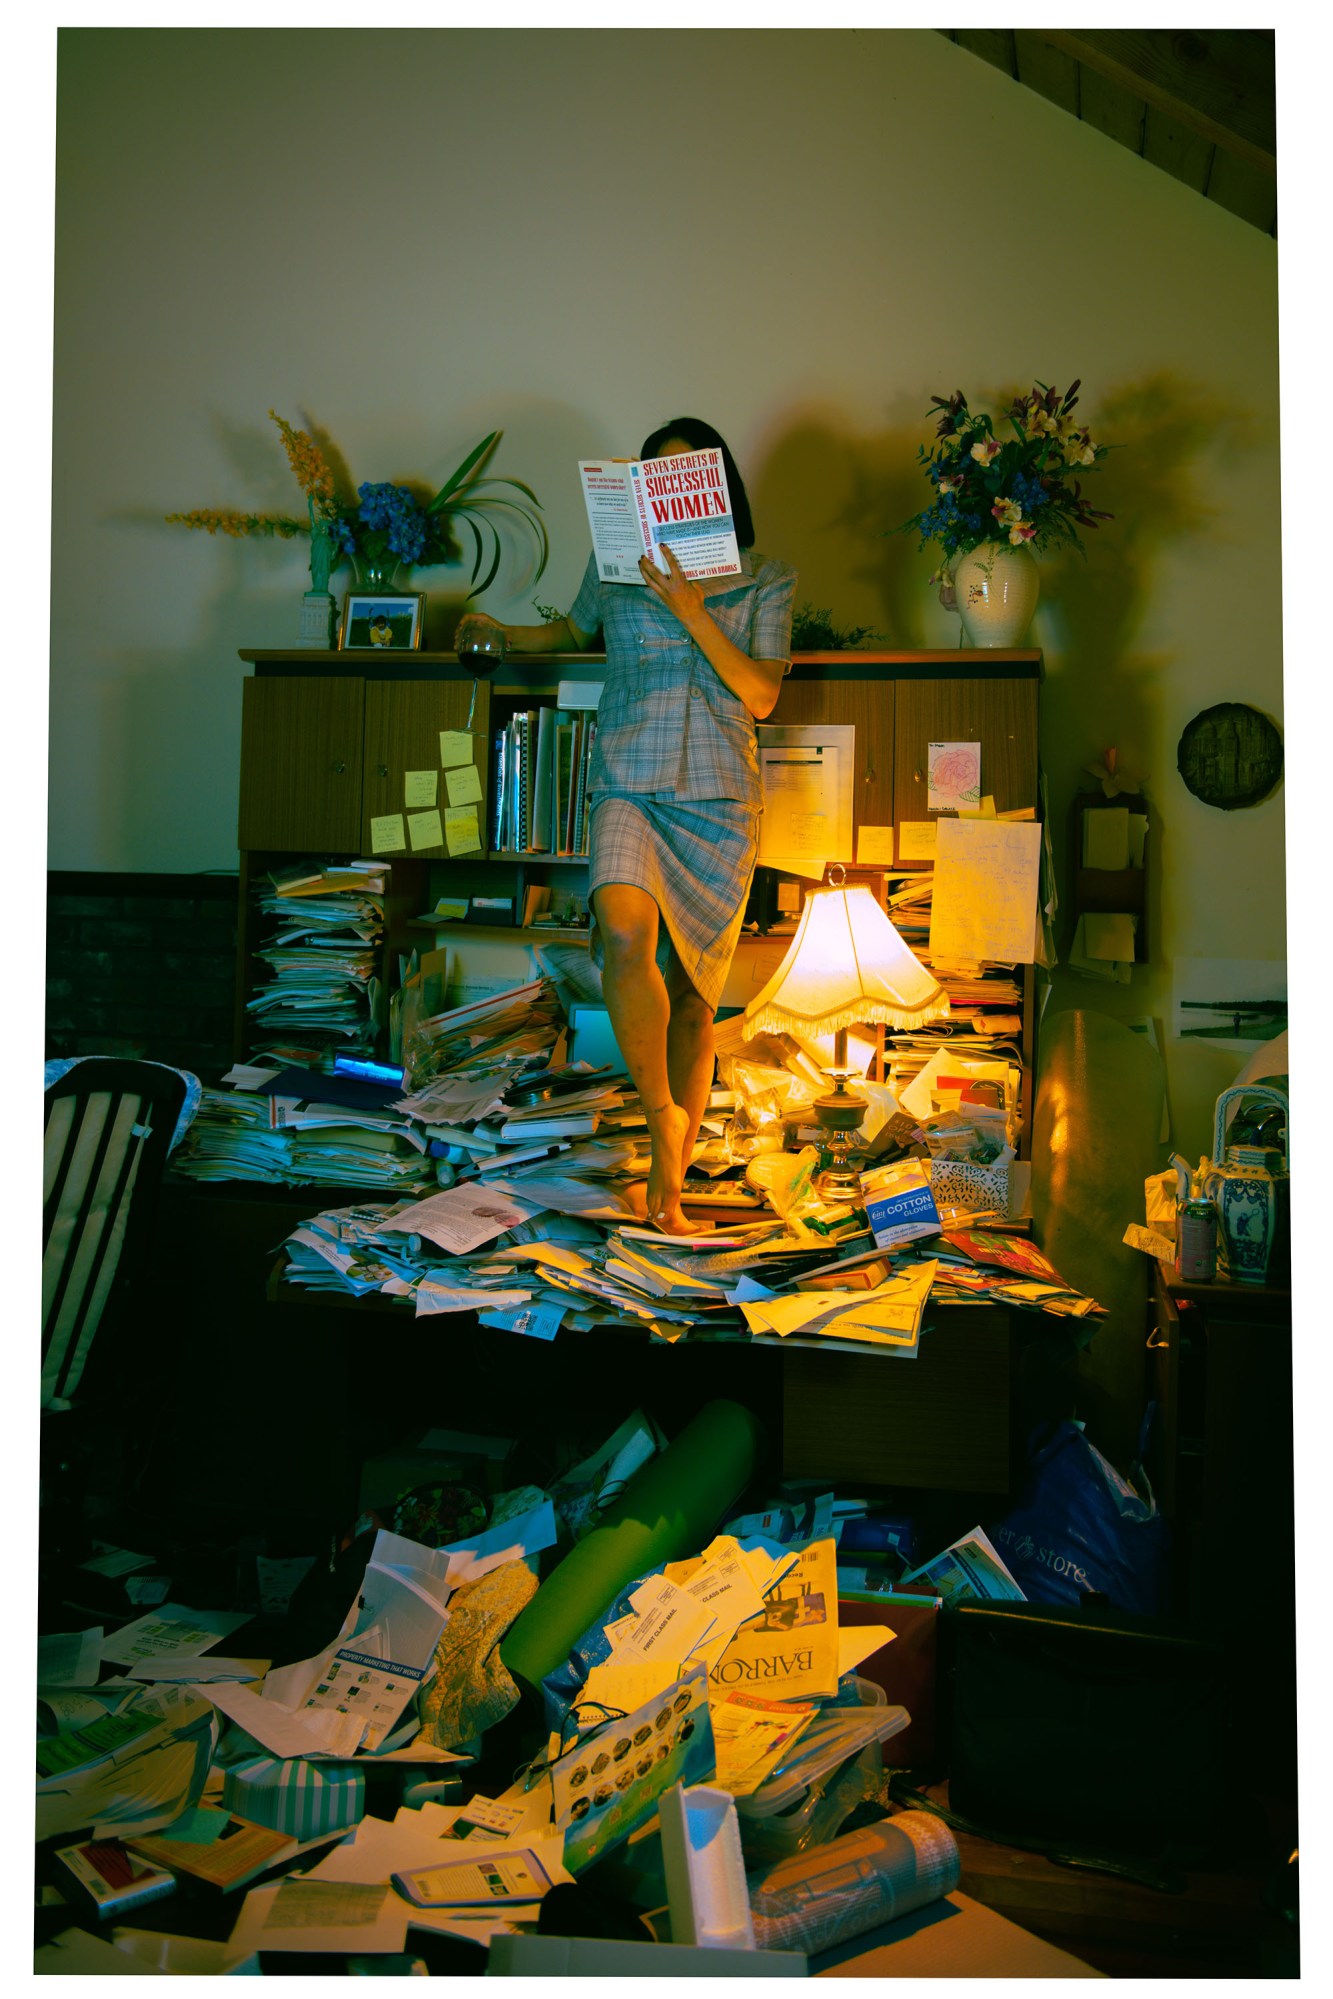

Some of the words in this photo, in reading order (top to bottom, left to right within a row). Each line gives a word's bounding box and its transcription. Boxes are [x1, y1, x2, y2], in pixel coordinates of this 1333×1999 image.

[643, 461, 668, 476] SEVEN
[670, 455, 708, 470] SECRETS
[709, 452, 720, 465] OF
[646, 467, 723, 498] SUCCESSFUL
[651, 490, 727, 524] WOMEN
[887, 1195, 931, 1215] COTTON
[904, 1203, 933, 1217] GLOVES
[1036, 1547, 1086, 1583] store
[702, 1591, 719, 1603] CLASS
[719, 1583, 732, 1594] MAIL
[643, 1634, 656, 1651] FIRST
[654, 1618, 668, 1636] CLASS
[665, 1608, 677, 1622] MAIL
[339, 1650, 364, 1662] PROPERTY
[363, 1657, 390, 1669] MARKETING
[390, 1664, 402, 1672] THAT
[402, 1667, 422, 1678] WORKS
